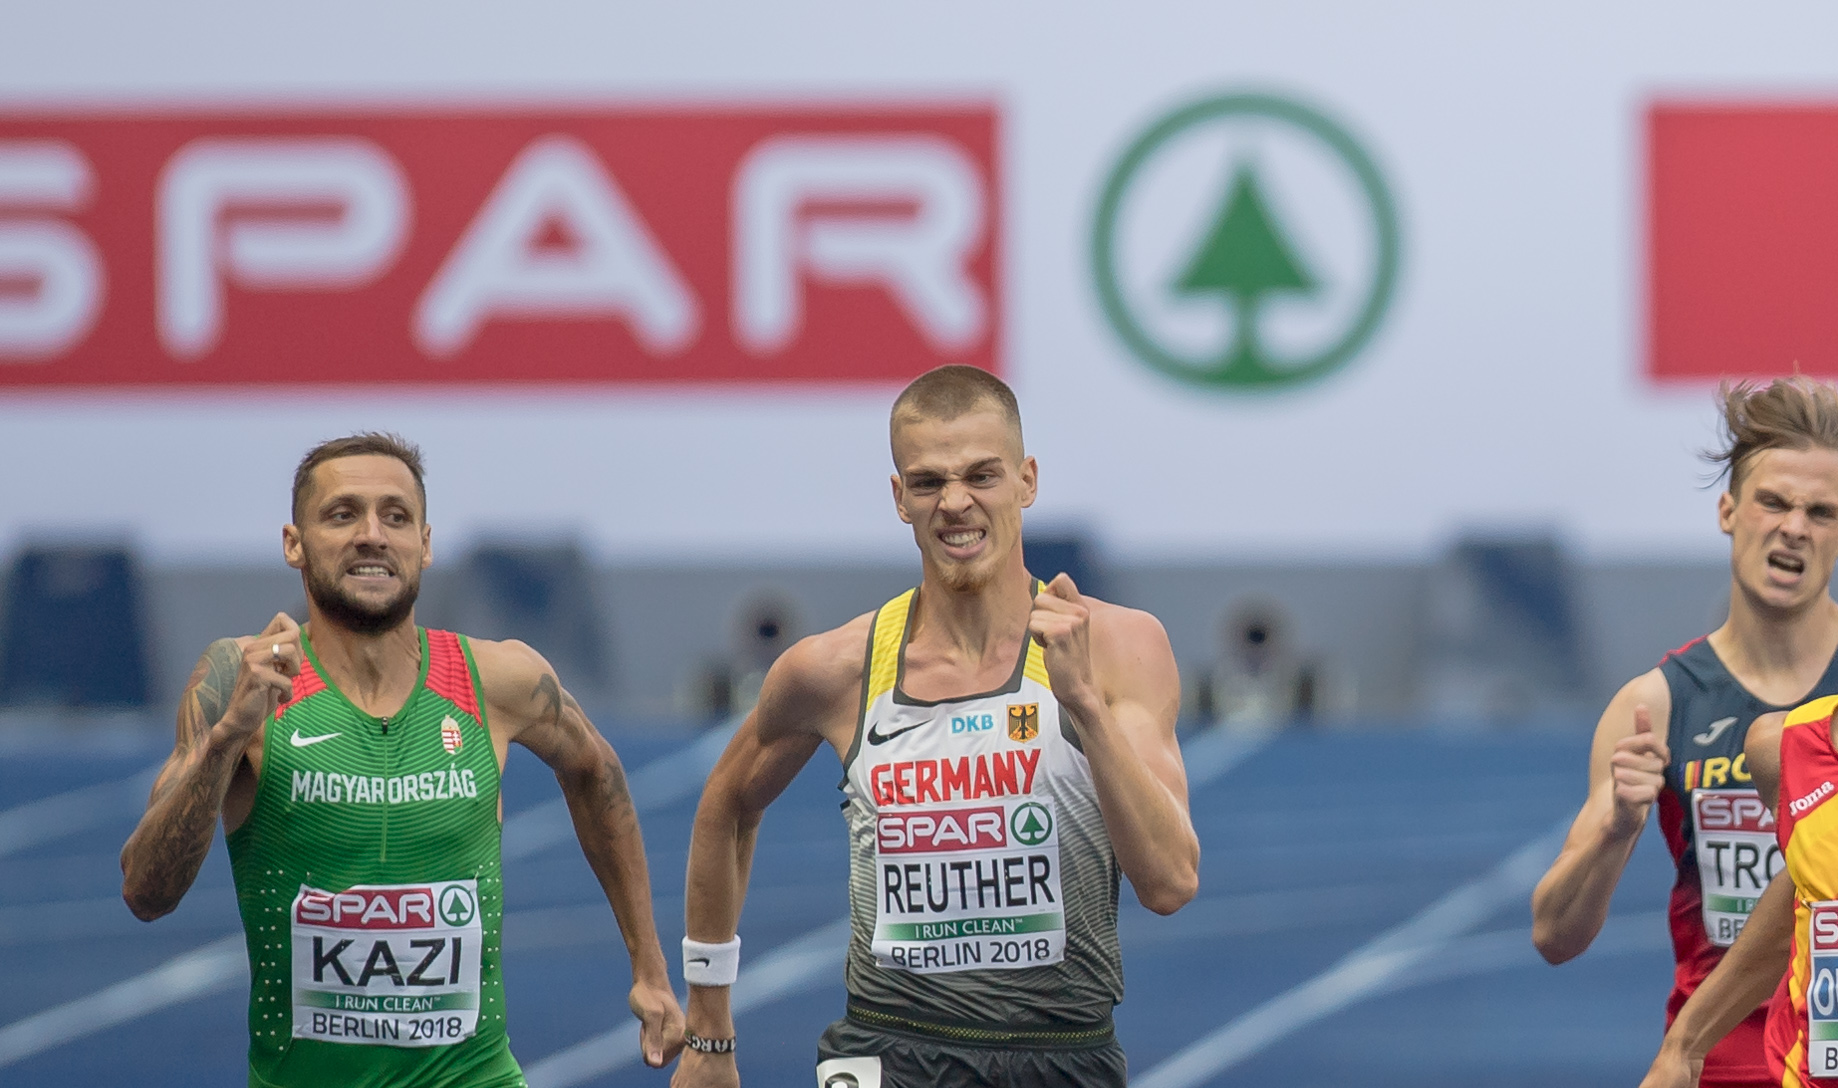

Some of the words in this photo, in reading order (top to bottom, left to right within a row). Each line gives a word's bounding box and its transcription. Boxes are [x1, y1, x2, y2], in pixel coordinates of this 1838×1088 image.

[951, 714, 994, 734] DKB
[291, 762, 477, 803] MAGYARORSZÁG
[870, 748, 1042, 807] GERMANY
[878, 812, 1003, 848] SPAR
[883, 854, 1056, 914] REUTHER
[300, 892, 431, 925] SPAR
[915, 925, 920, 938] I
[923, 923, 958, 938] RUN
[312, 936, 462, 987] KAZI
[891, 941, 981, 968] BERLIN
[990, 938, 1050, 963] 2018
[335, 995, 340, 1008] I
[345, 996, 378, 1010] RUN
[313, 1013, 399, 1040] BERLIN
[409, 1017, 462, 1041] 2018
